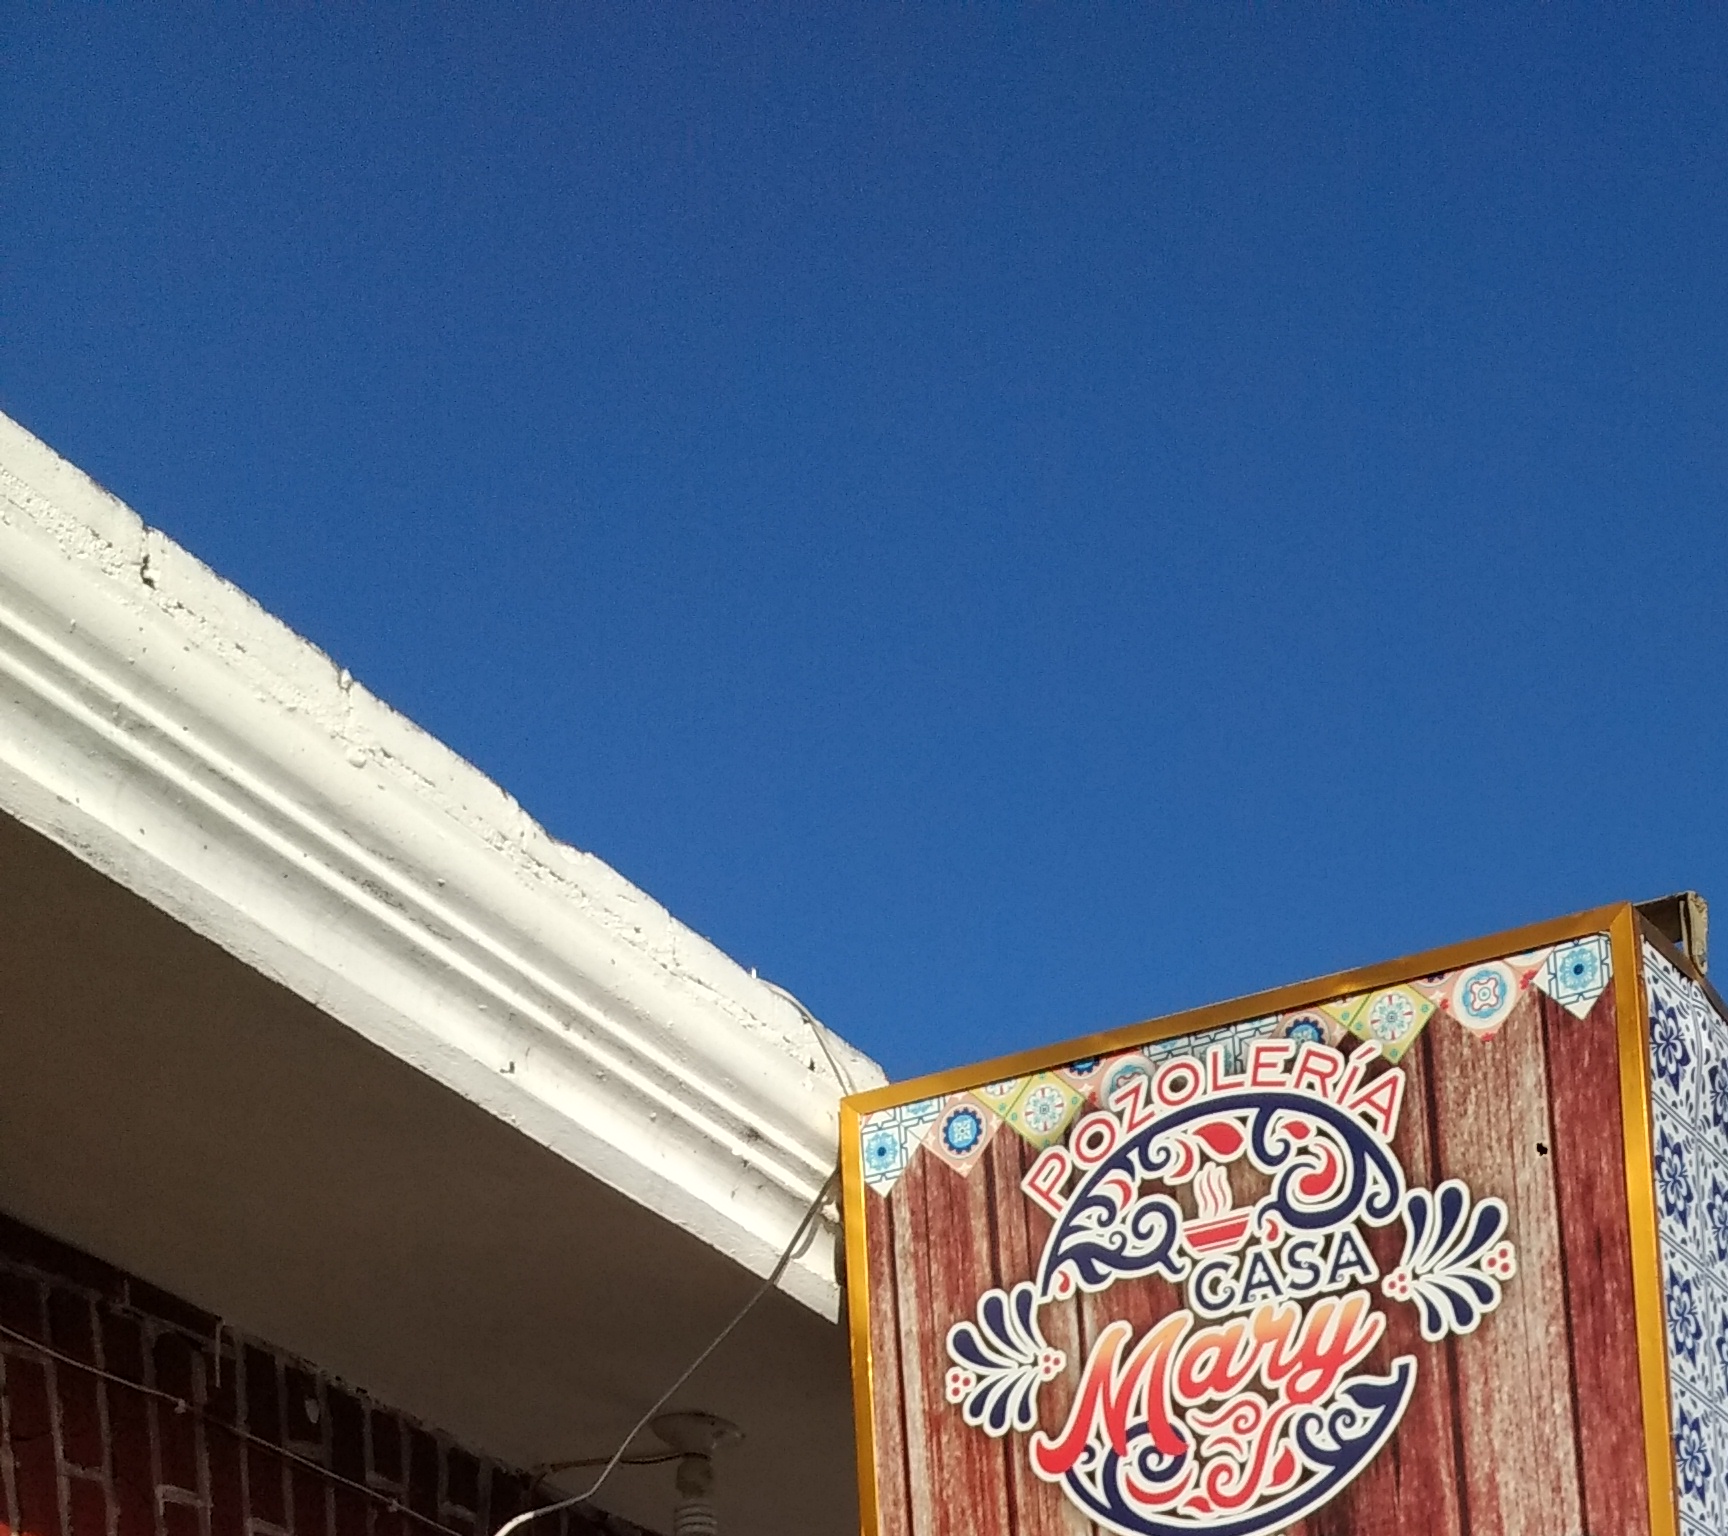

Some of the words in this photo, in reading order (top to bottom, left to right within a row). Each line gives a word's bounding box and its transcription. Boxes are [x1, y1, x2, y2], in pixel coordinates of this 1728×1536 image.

[1023, 1043, 1403, 1214] POZOLERÍA
[1194, 1230, 1373, 1311] CASA
[1035, 1294, 1386, 1480] Mary
